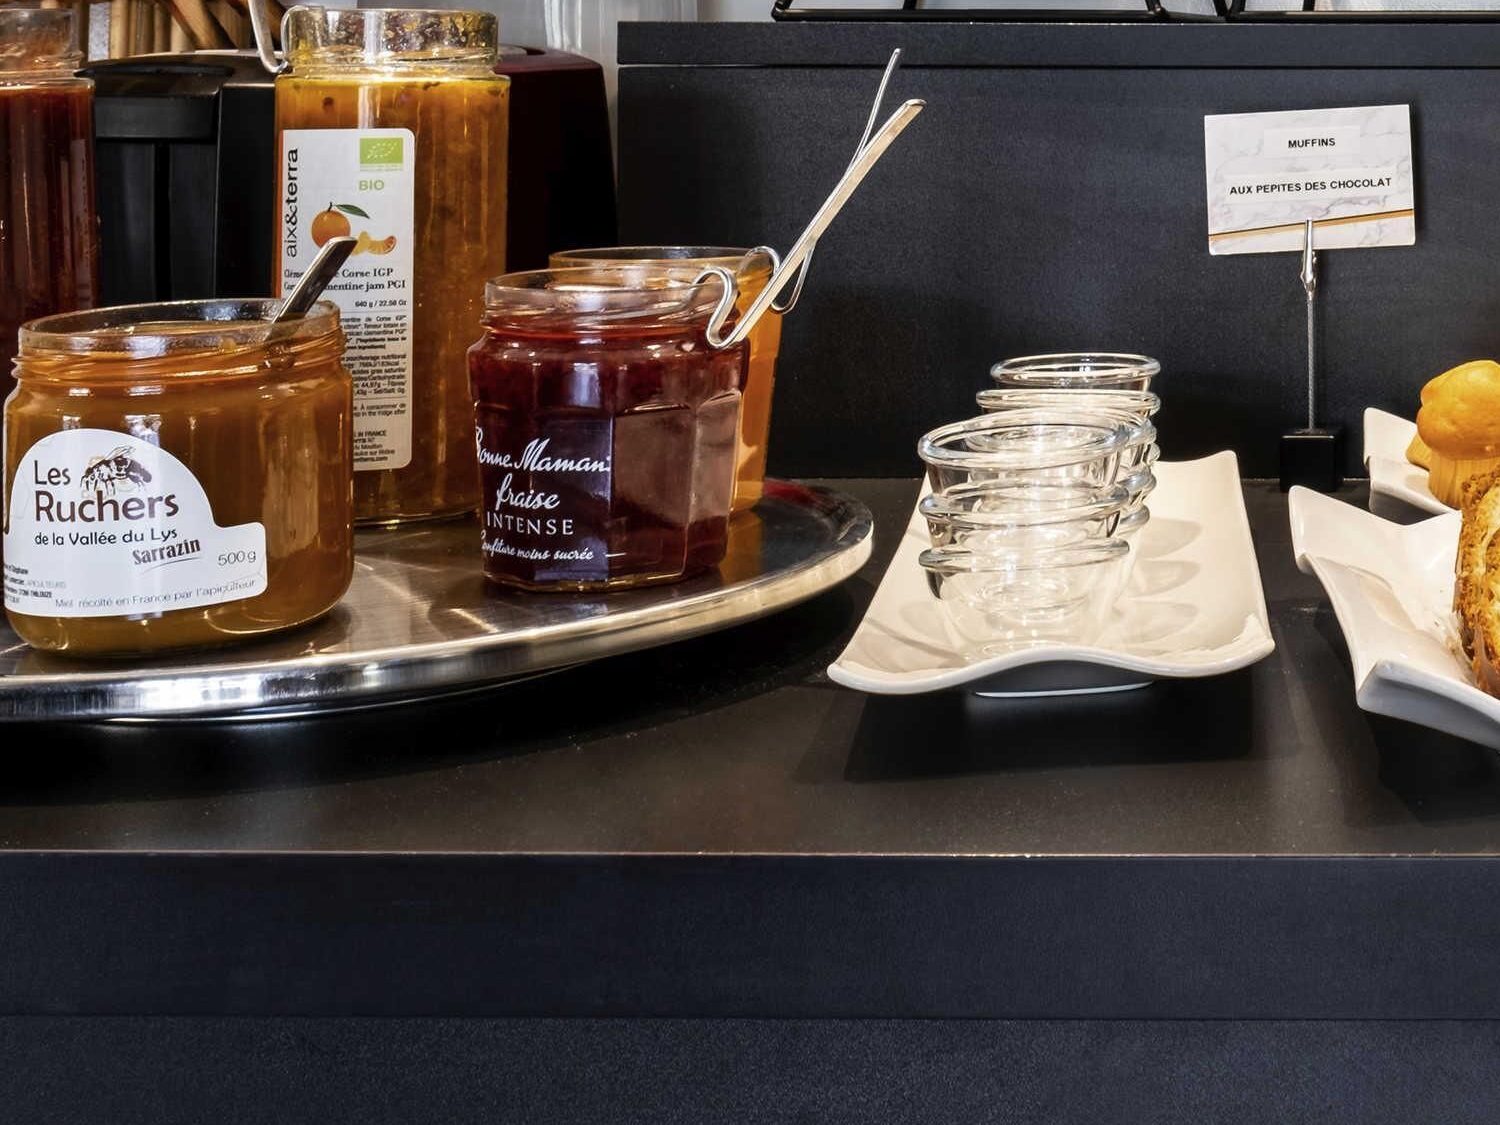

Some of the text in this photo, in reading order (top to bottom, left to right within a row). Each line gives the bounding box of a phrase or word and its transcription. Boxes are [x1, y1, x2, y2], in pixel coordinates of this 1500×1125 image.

[1288, 138, 1336, 149] MUFFINS
[359, 179, 385, 191] BIO
[1230, 178, 1392, 195] AUX PEPITES DES CHOCOLAT
[341, 269, 371, 278] Corse
[373, 268, 394, 277] IGP
[365, 283, 385, 292] jam
[387, 280, 406, 289] PGI
[514, 437, 610, 472] Maman
[34, 460, 71, 485] Les
[496, 473, 560, 511] fraise
[35, 490, 179, 523] Ruchers
[487, 511, 574, 535] INTENSE
[34, 527, 178, 546] de la Vallée du Lys
[132, 538, 201, 565] Sarrazin
[516, 548, 550, 560] moins
[554, 547, 594, 560] sucrée
[115, 598, 130, 606] en
[132, 594, 172, 605] France
[174, 591, 192, 602] par
